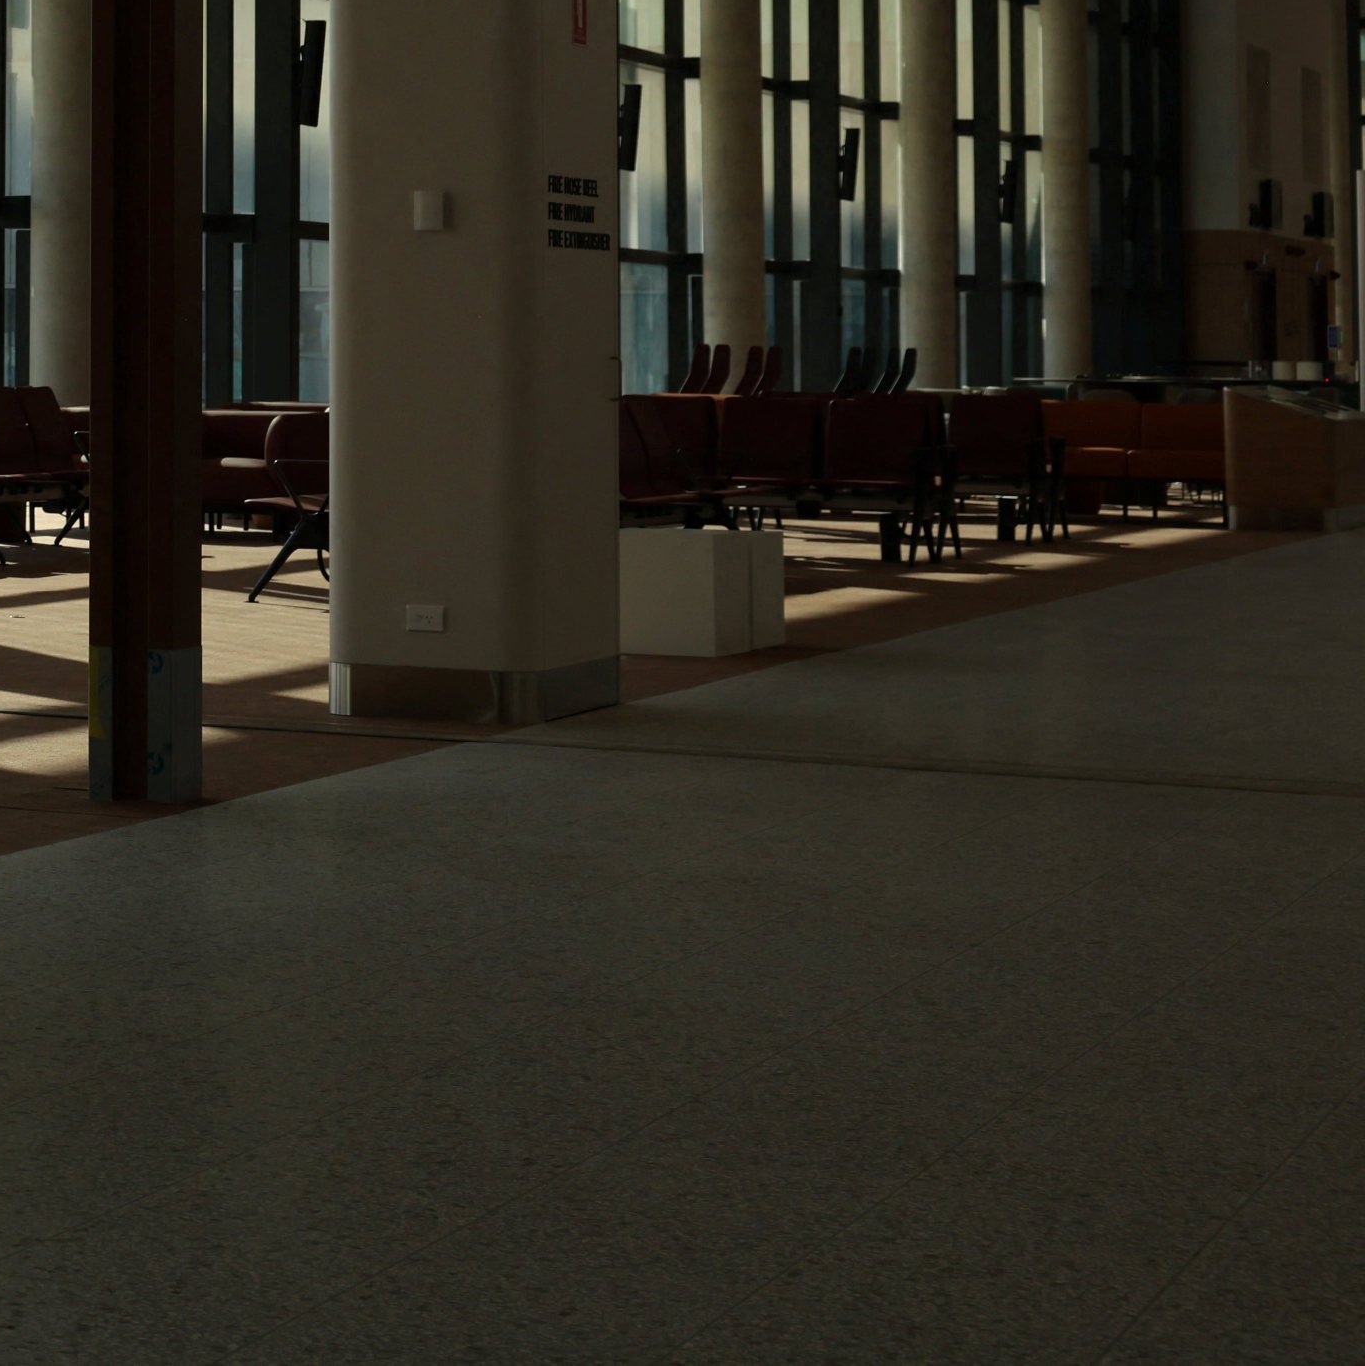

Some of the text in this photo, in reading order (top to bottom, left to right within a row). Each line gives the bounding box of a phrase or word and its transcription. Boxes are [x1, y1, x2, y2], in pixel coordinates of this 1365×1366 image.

[548, 175, 563, 193] FIRE
[548, 201, 563, 220] FIRE
[548, 229, 563, 247] FIRE
